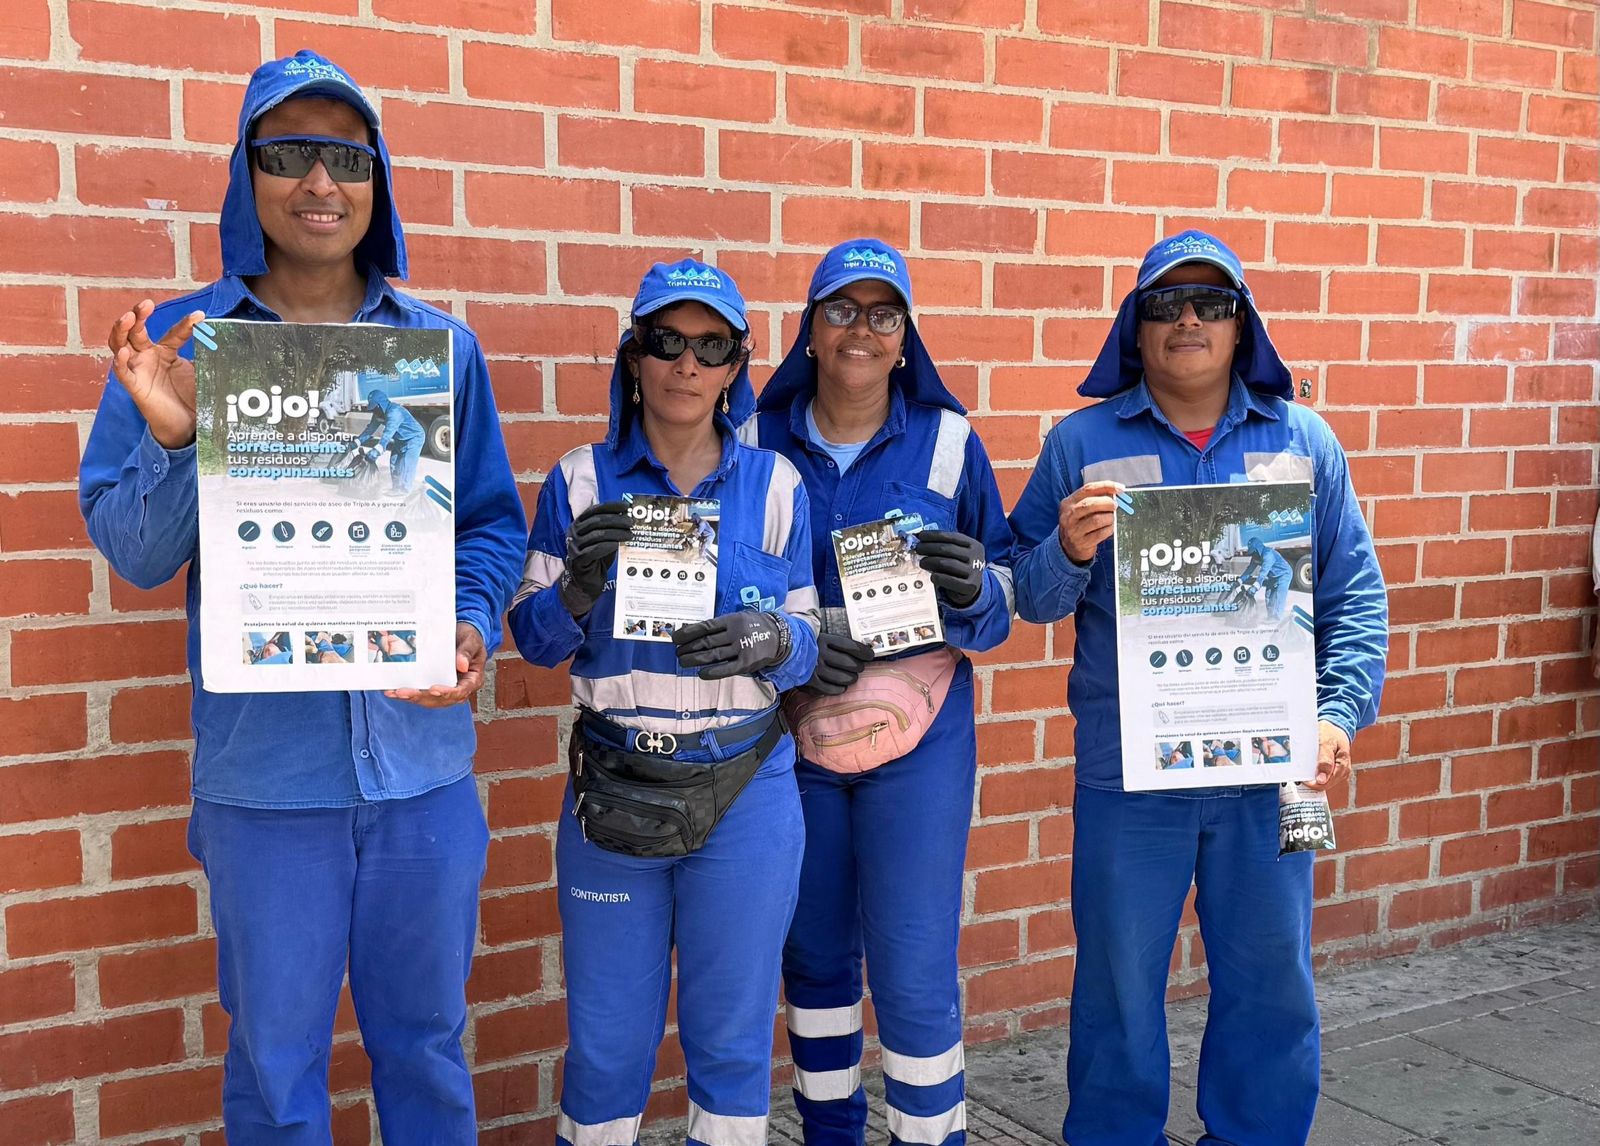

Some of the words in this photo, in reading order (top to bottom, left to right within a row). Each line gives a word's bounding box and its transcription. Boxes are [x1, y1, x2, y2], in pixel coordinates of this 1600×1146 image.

[226, 385, 320, 425] ¡Ojo!
[226, 430, 284, 443] Aprende
[287, 432, 295, 441] a
[298, 430, 355, 443] disponer
[226, 442, 347, 453] correctamente
[227, 455, 249, 465] tus
[252, 454, 308, 466] residuos
[228, 466, 355, 480] cortopunzantes
[624, 541, 683, 550] cortopunzantes
[839, 531, 879, 554] ¡Ojo!
[1140, 539, 1211, 572] ¡Ojo!
[239, 582, 258, 590] ¿Qué
[1140, 575, 1184, 588] Aprende
[1186, 576, 1192, 584] a
[1194, 574, 1238, 585] disponer
[1140, 582, 1231, 596] correctamente
[1141, 597, 1157, 606] tus
[1159, 595, 1202, 605] residuos
[1142, 602, 1239, 617] cortopunzantes
[740, 631, 771, 649] HyFlex
[1288, 823, 1329, 842] ¡Ojo!
[571, 886, 631, 903] CONTRATISTA
